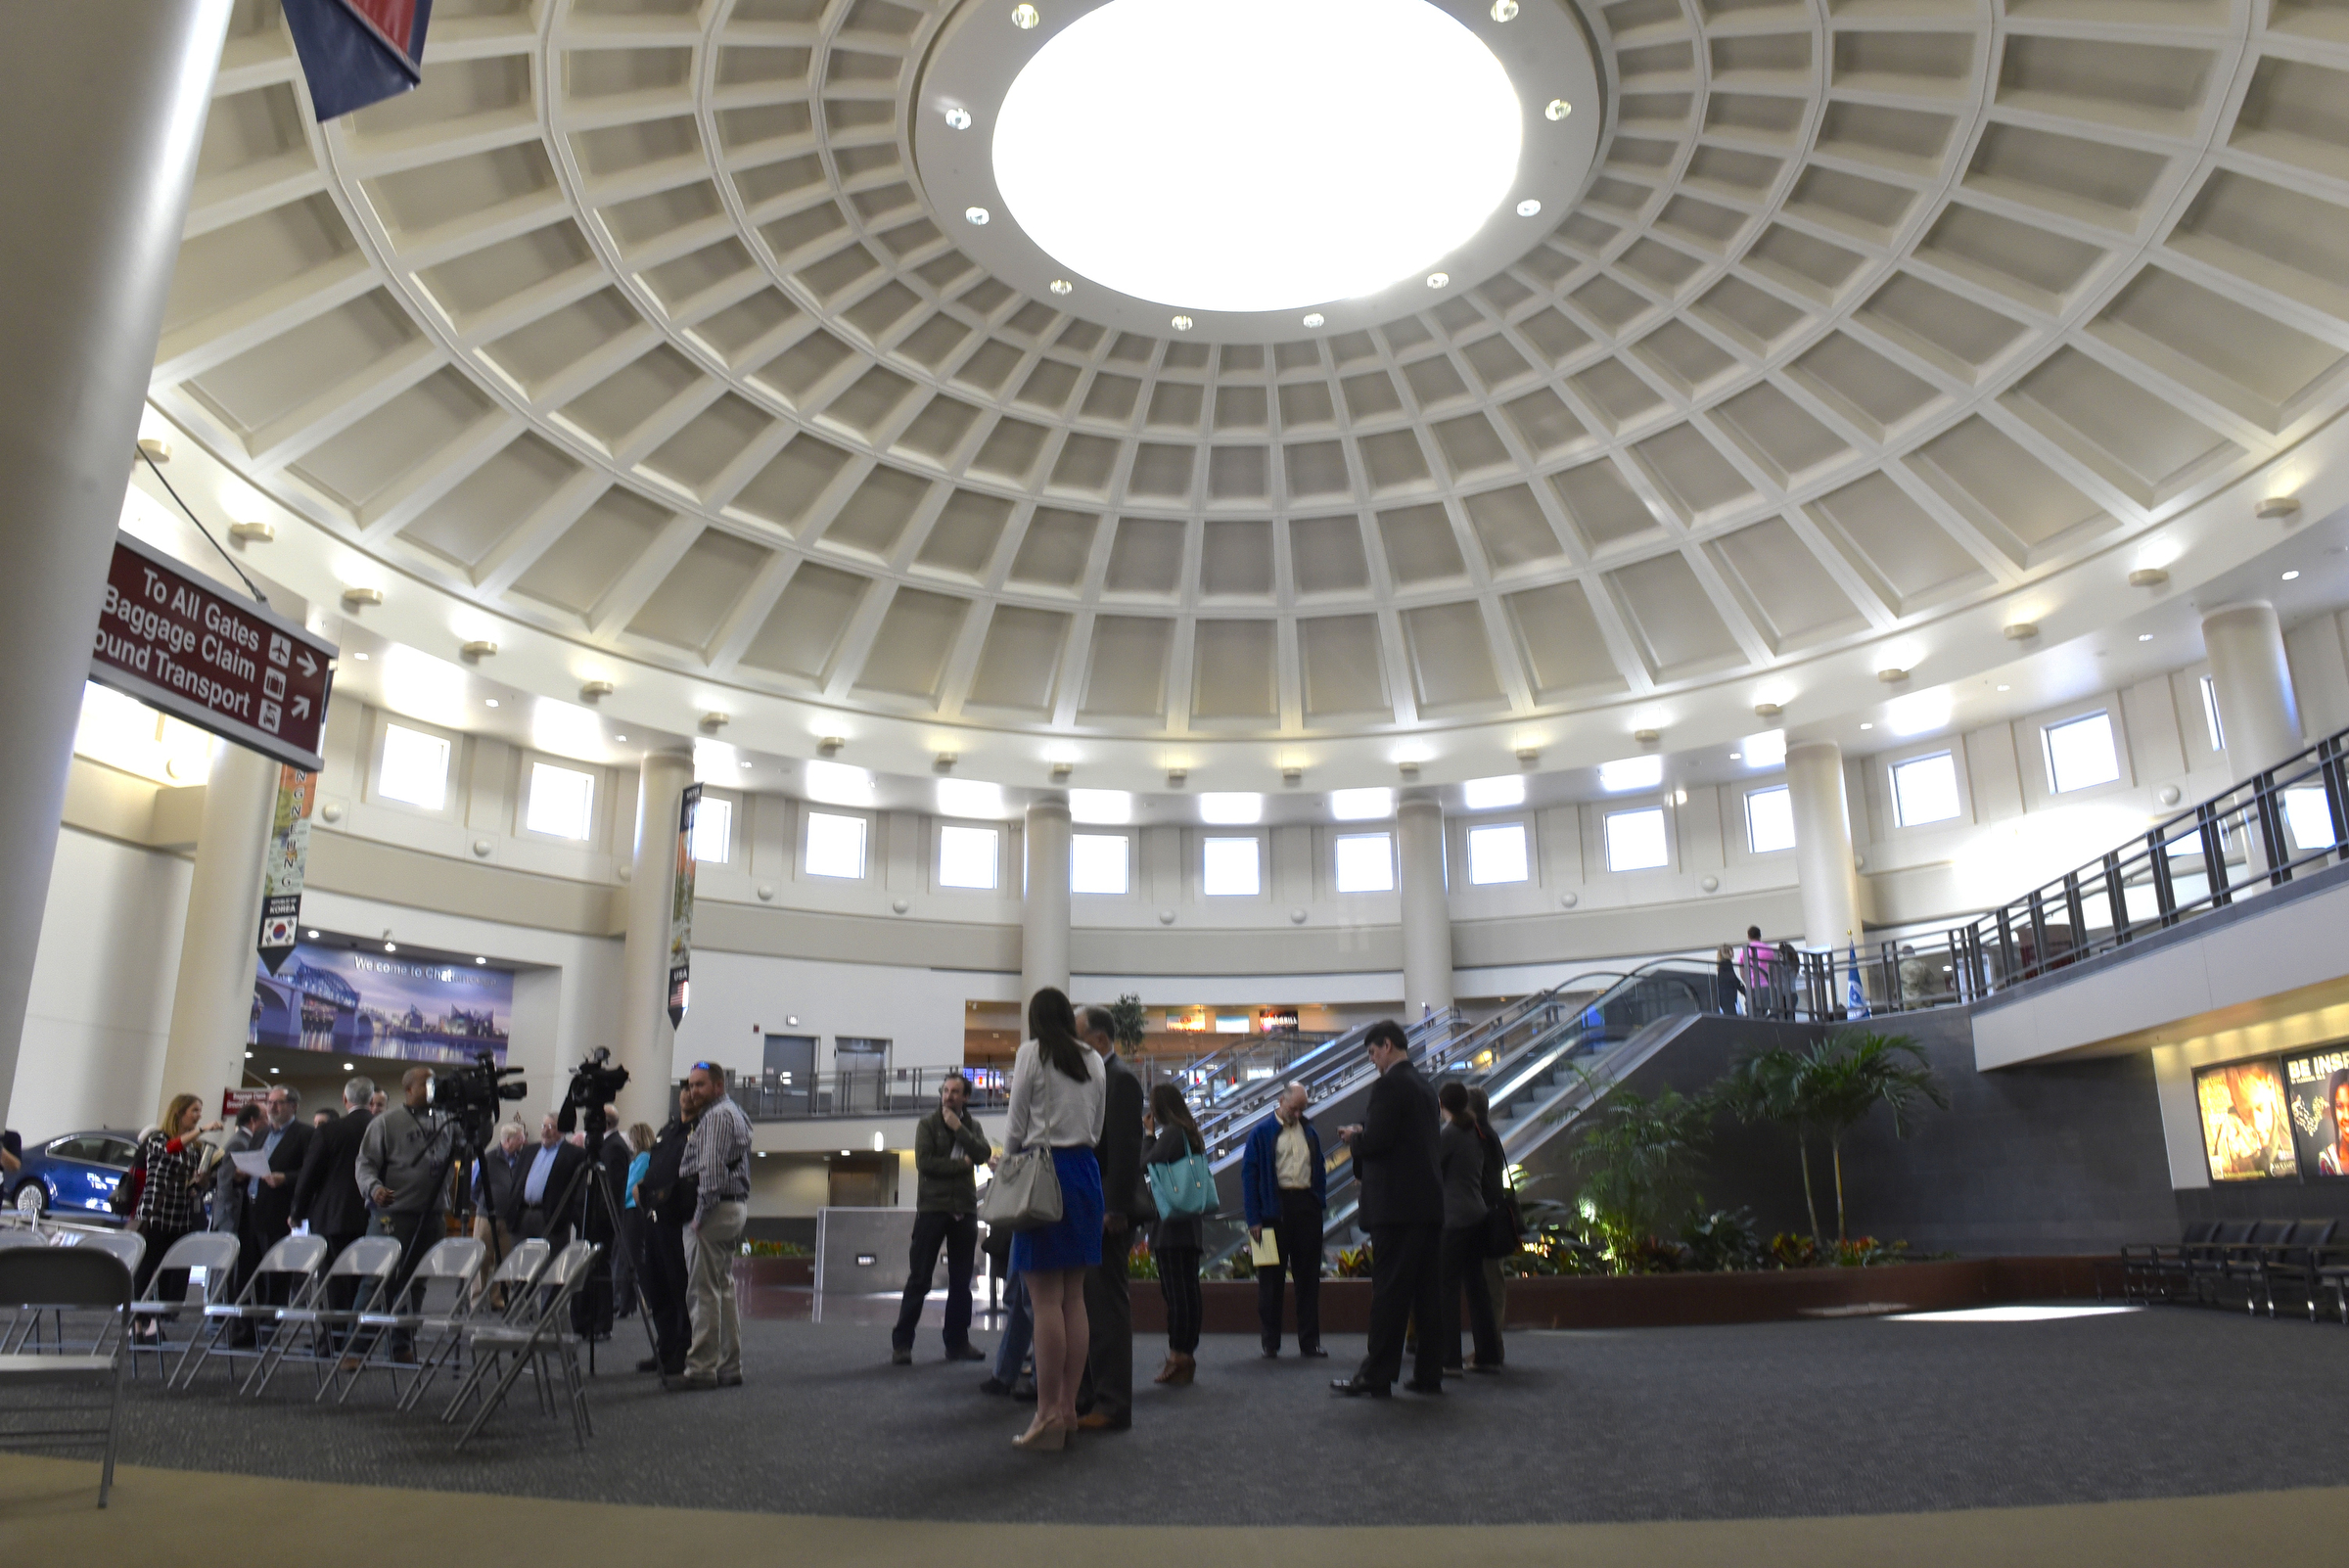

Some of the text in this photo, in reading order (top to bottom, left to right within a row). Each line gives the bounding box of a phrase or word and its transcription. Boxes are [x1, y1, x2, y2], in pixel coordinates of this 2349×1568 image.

[144, 567, 259, 652] To All Gates
[102, 584, 256, 683] Baggage Claim
[94, 627, 251, 717] ound Transport
[269, 903, 296, 915] KOREA
[410, 965, 422, 979] to
[673, 968, 687, 982] USA
[2287, 1058, 2311, 1079] BE
